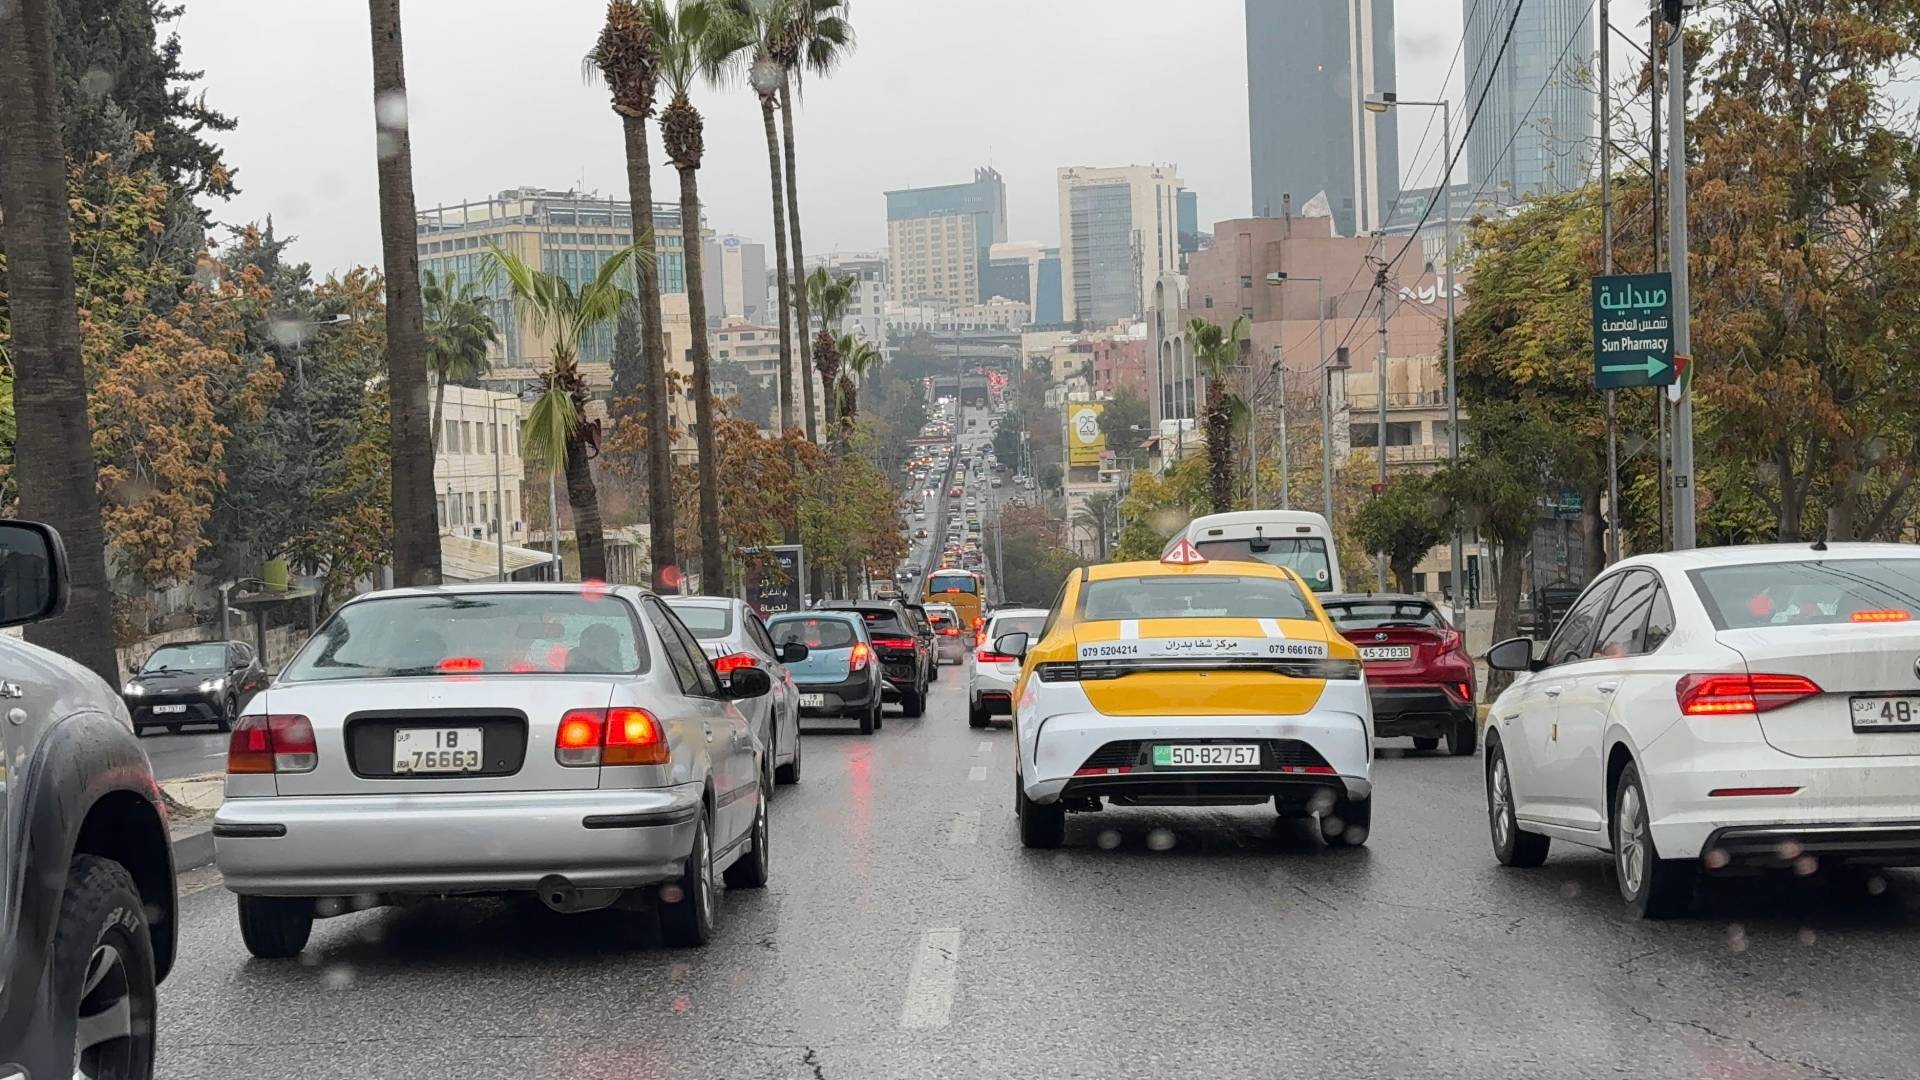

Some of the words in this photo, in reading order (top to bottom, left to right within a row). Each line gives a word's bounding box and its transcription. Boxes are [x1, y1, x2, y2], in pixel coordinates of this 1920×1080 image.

[1600, 283, 1667, 316] صيدلية
[1601, 318, 1637, 332] العاصمة
[1639, 316, 1668, 332] شمس
[1602, 338, 1620, 352] Sun
[1621, 336, 1668, 354] Pharmacy
[1079, 415, 1096, 433] 25
[1082, 647, 1098, 657] 079
[1100, 645, 1138, 656] 5204214
[1165, 640, 1193, 651] بدران
[1214, 639, 1238, 650] مركز
[1269, 645, 1285, 655] 079
[1287, 645, 1323, 656] 6661678
[436, 731, 458, 748] 18
[411, 750, 479, 769] 76663
